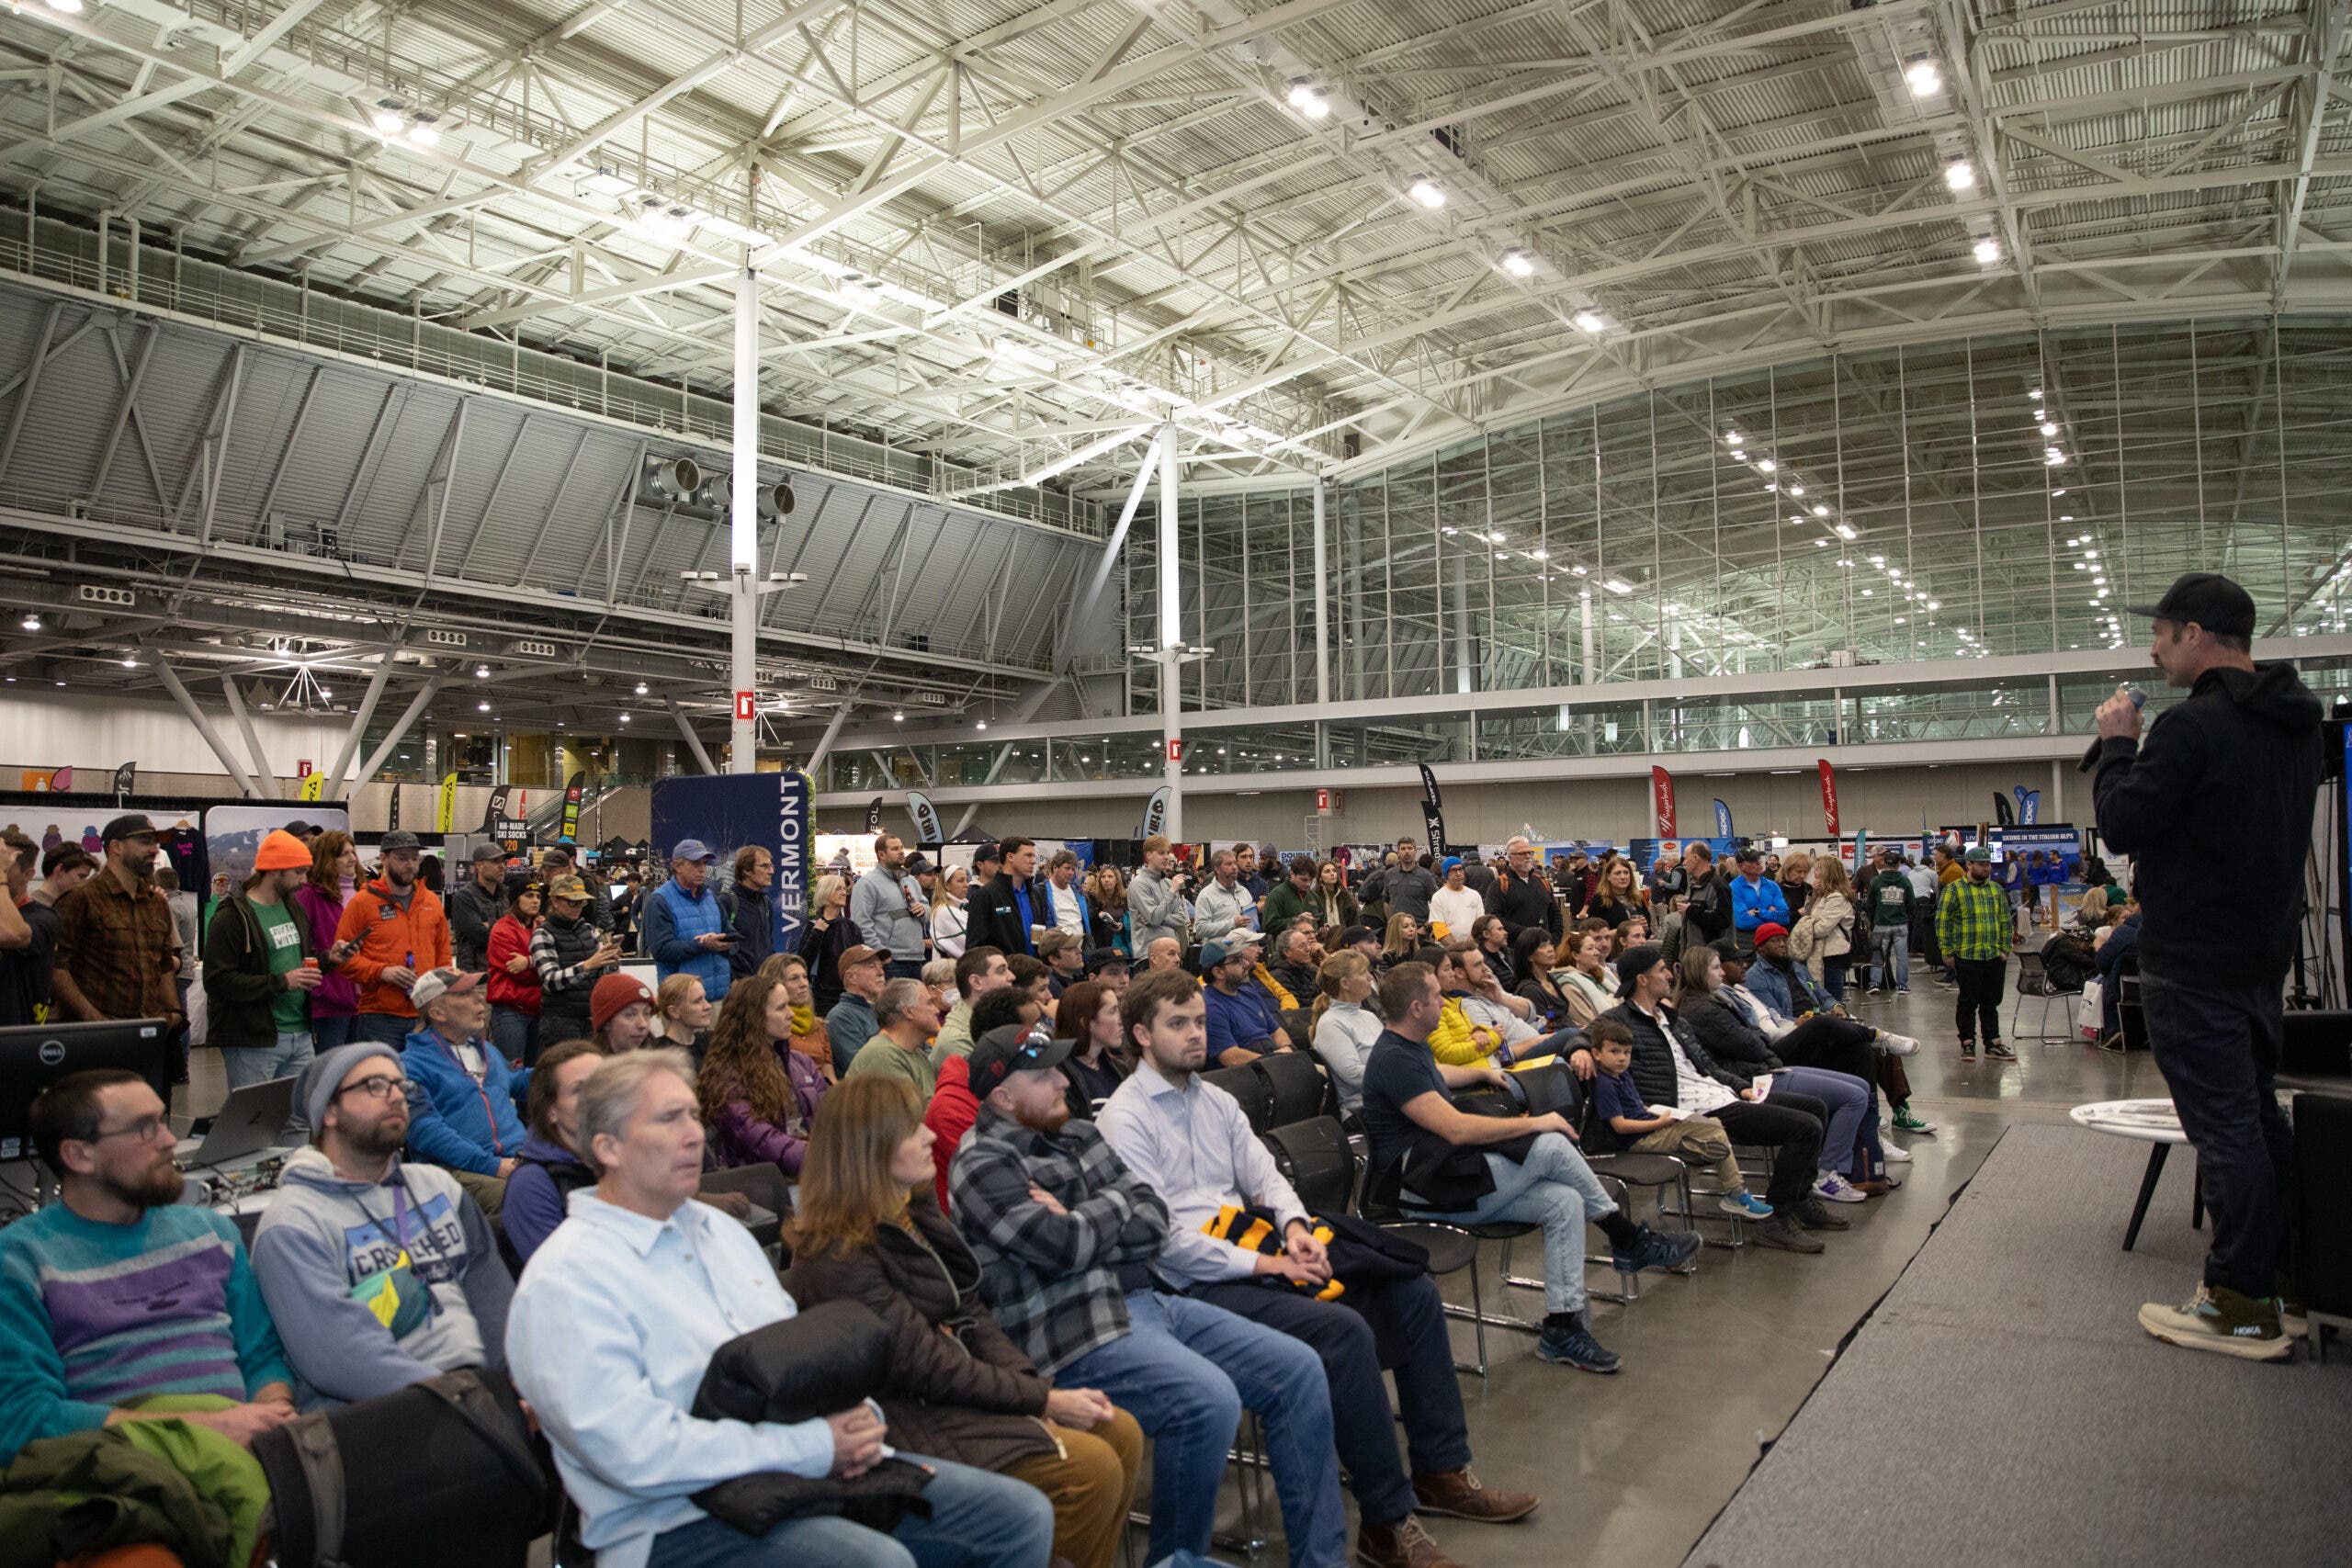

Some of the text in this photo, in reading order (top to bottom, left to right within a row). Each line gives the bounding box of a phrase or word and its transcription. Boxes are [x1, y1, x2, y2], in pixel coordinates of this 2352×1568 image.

[1659, 782, 1672, 818] Sugarbush
[499, 822, 526, 830] NH-MADE
[497, 830, 527, 839] SKI SOCKS
[504, 840, 518, 852] $20
[780, 775, 801, 933] VERMONT
[43, 1048, 62, 1056] DELL
[2233, 1325, 2262, 1337] HOKA
